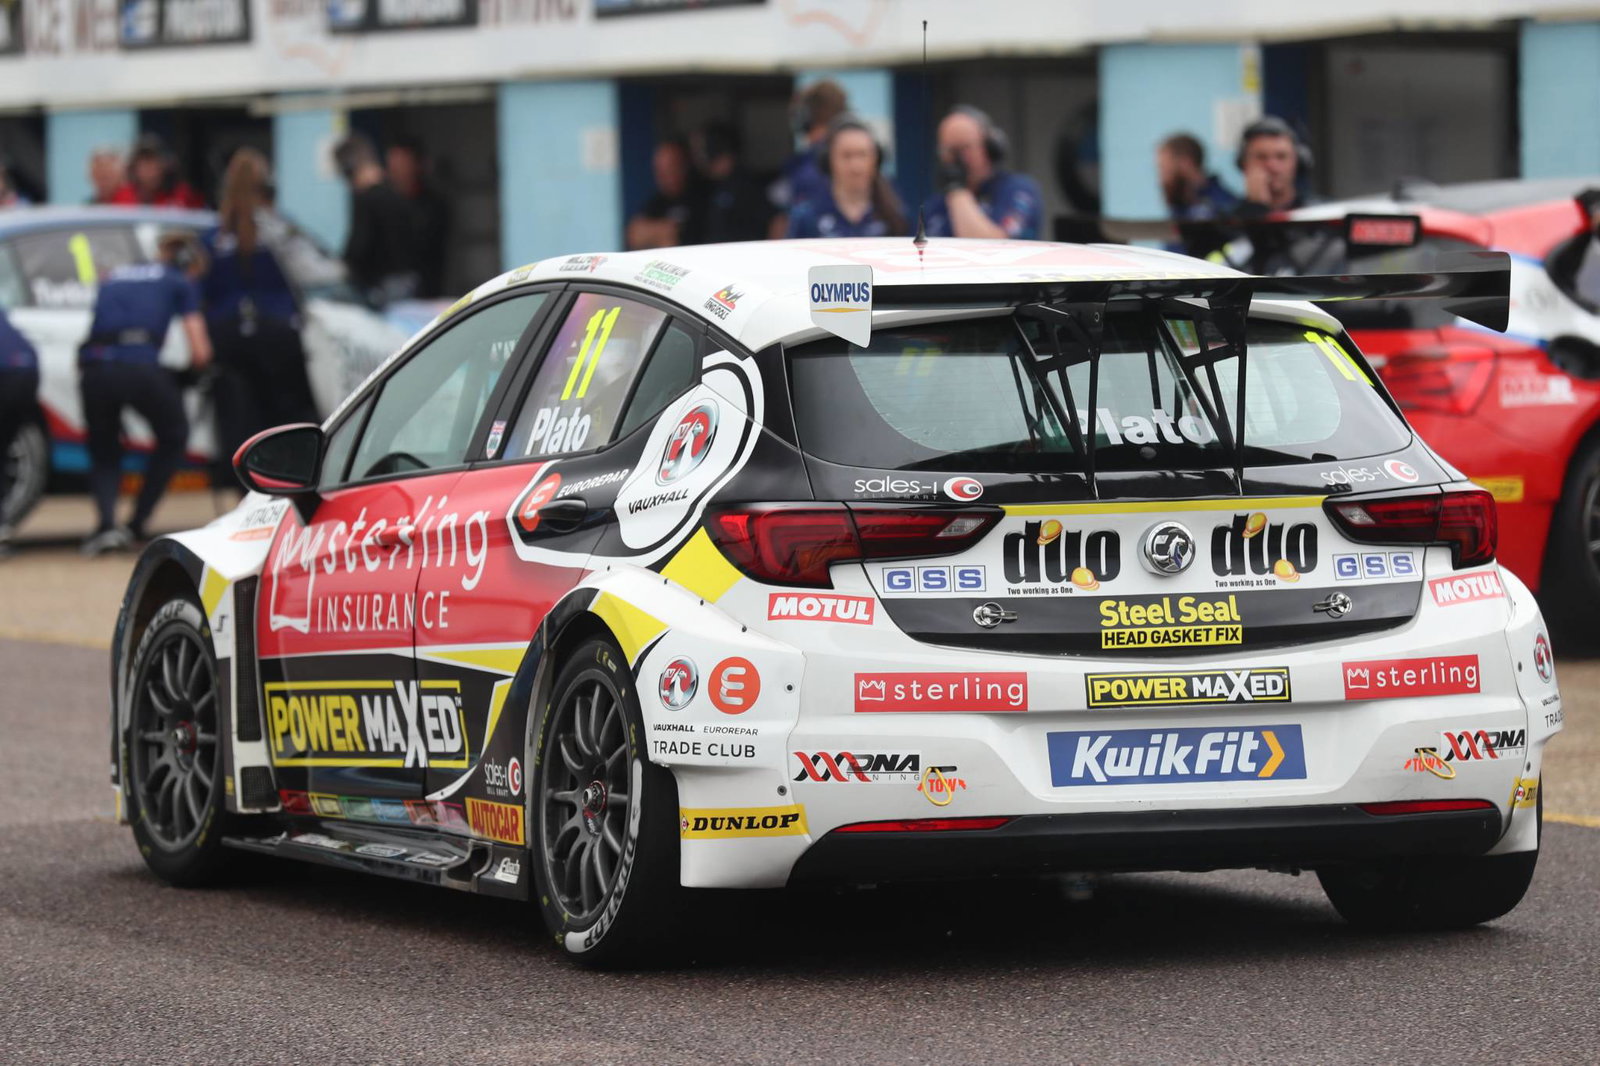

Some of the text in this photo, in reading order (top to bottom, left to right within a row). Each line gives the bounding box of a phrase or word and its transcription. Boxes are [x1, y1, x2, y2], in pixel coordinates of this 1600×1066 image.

[811, 282, 870, 303] OLYMPUS
[560, 307, 621, 401] 11
[524, 407, 592, 457] Plato
[557, 468, 630, 499] EUROREPAR
[628, 488, 689, 515] VAUXHALL
[1003, 520, 1121, 584] duo
[1211, 512, 1319, 577] duo
[1337, 554, 1413, 578] GSS
[886, 569, 983, 590] GSS
[1007, 587, 1073, 596] Two working as One
[1215, 580, 1228, 588] Two
[1229, 579, 1254, 588] working
[1264, 579, 1276, 587] One
[1436, 576, 1503, 602] MOTUL
[317, 591, 450, 633] INSURANCE
[771, 597, 871, 620] MOTUL
[1101, 595, 1241, 627] Steel Seal
[1104, 626, 1240, 646] HEAD GASKET FIX
[1094, 670, 1285, 702] POWER MAXED
[1376, 661, 1478, 688] sterling
[894, 677, 1024, 707] sterling
[271, 695, 365, 752] POWER
[361, 680, 462, 769] MAXED
[653, 723, 759, 736] VAUXHALL EUROREPAR
[653, 740, 702, 756] TRADE
[707, 742, 756, 758] CLUB
[1483, 729, 1525, 749] DNA
[847, 754, 920, 772] DNA
[928, 778, 957, 793] TOW
[471, 800, 520, 842] AUTOCAR
[692, 813, 800, 832] DUNLOP
